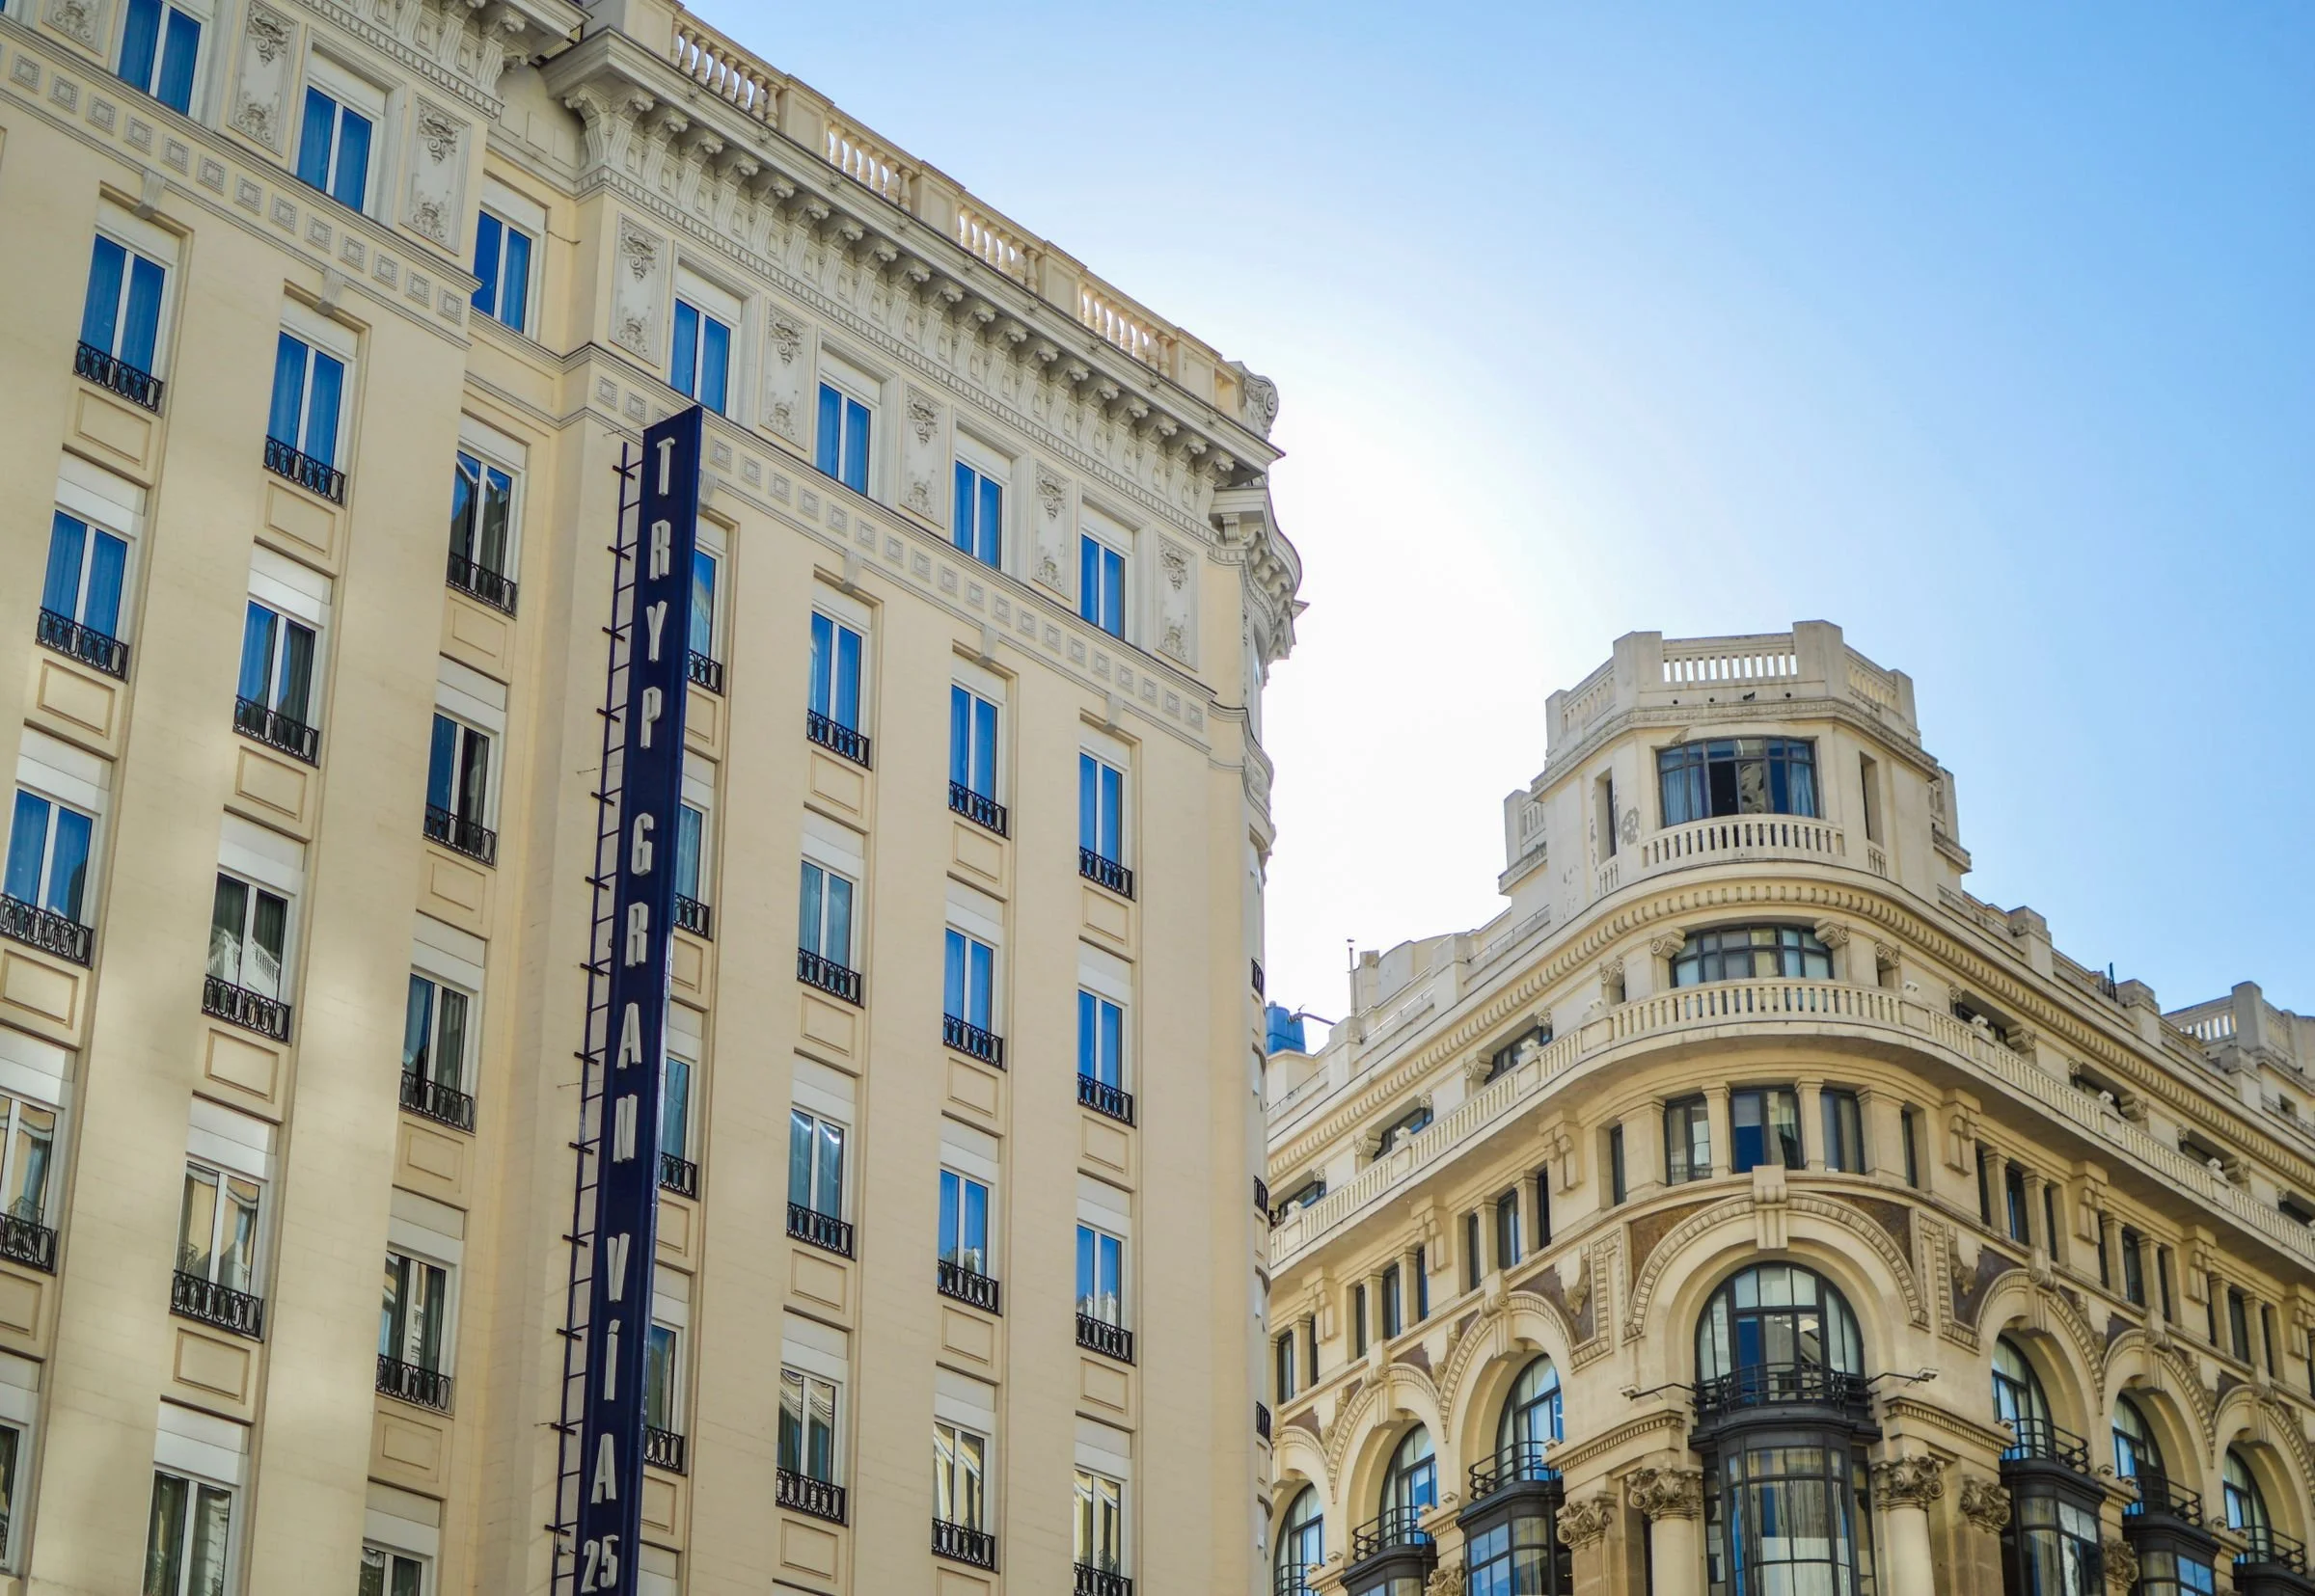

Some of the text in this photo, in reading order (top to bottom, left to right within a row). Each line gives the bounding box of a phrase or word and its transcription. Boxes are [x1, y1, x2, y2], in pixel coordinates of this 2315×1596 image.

[640, 436, 676, 749] TRYP
[613, 812, 654, 1162] GRAN
[581, 1534, 619, 1593] 25
